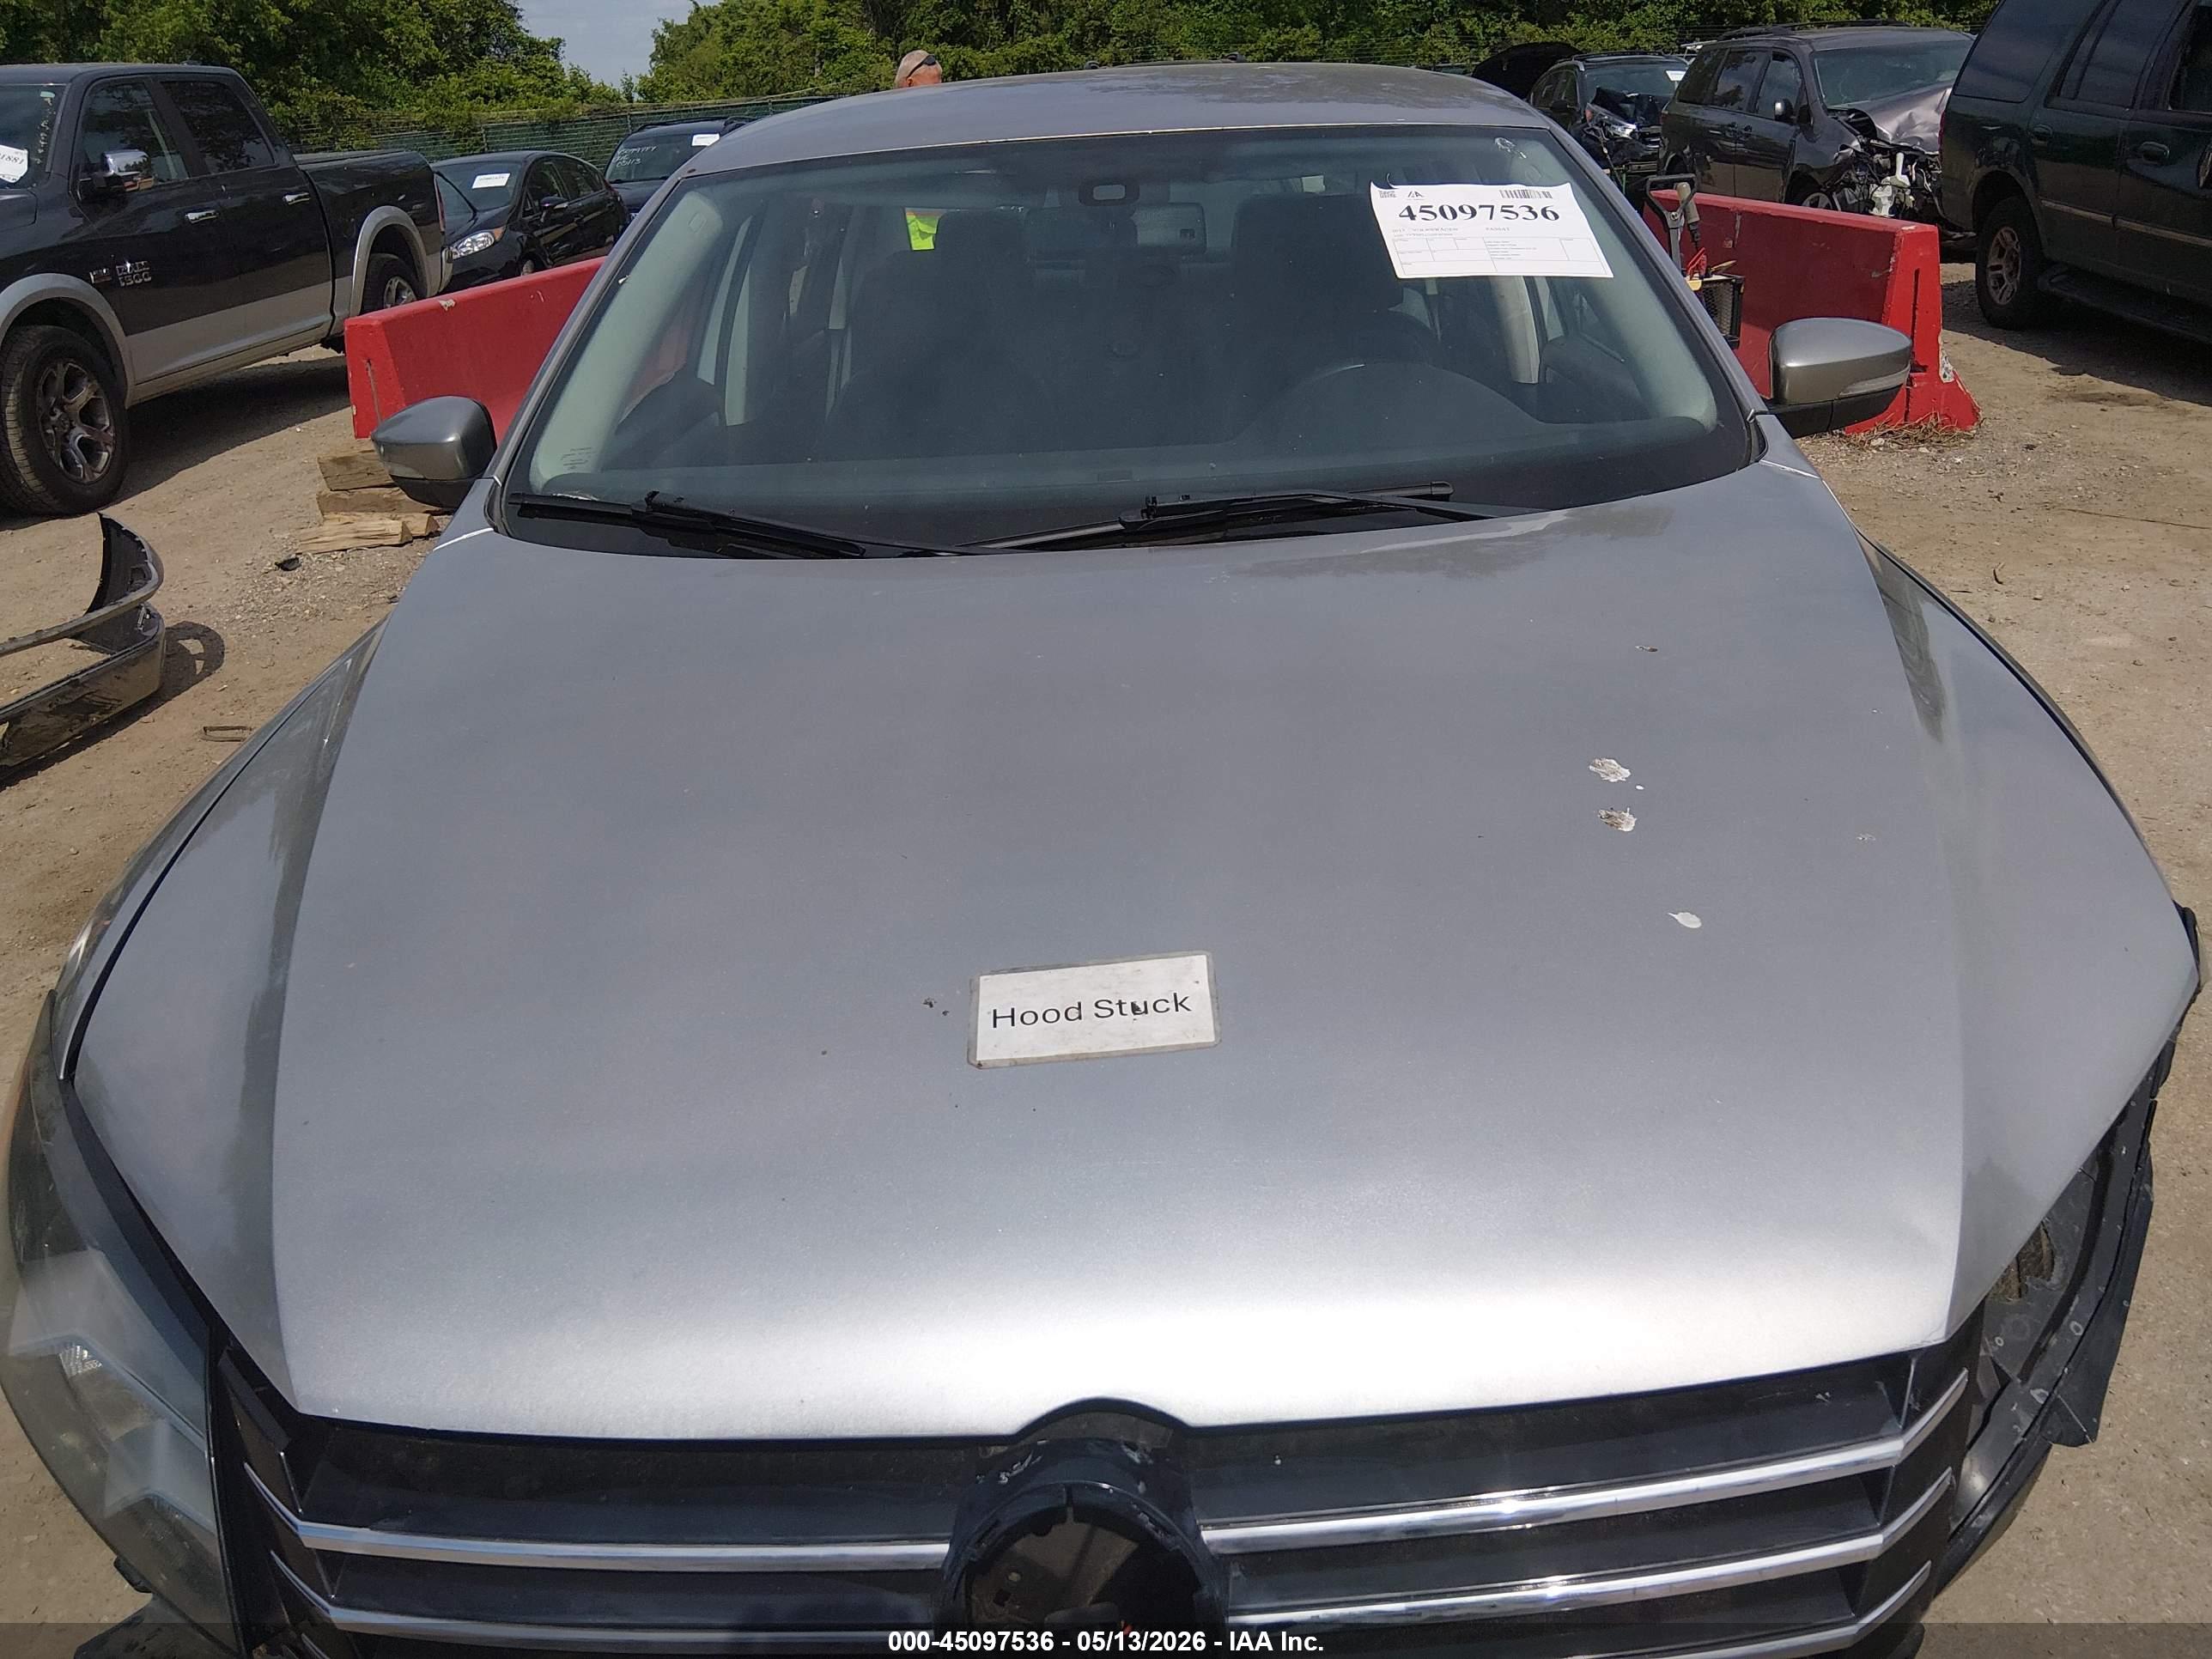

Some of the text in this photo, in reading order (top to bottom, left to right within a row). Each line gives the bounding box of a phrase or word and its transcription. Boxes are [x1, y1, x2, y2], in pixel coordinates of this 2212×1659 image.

[1399, 204, 1560, 221] 45097536
[993, 992, 1192, 1029] Hood Stuck
